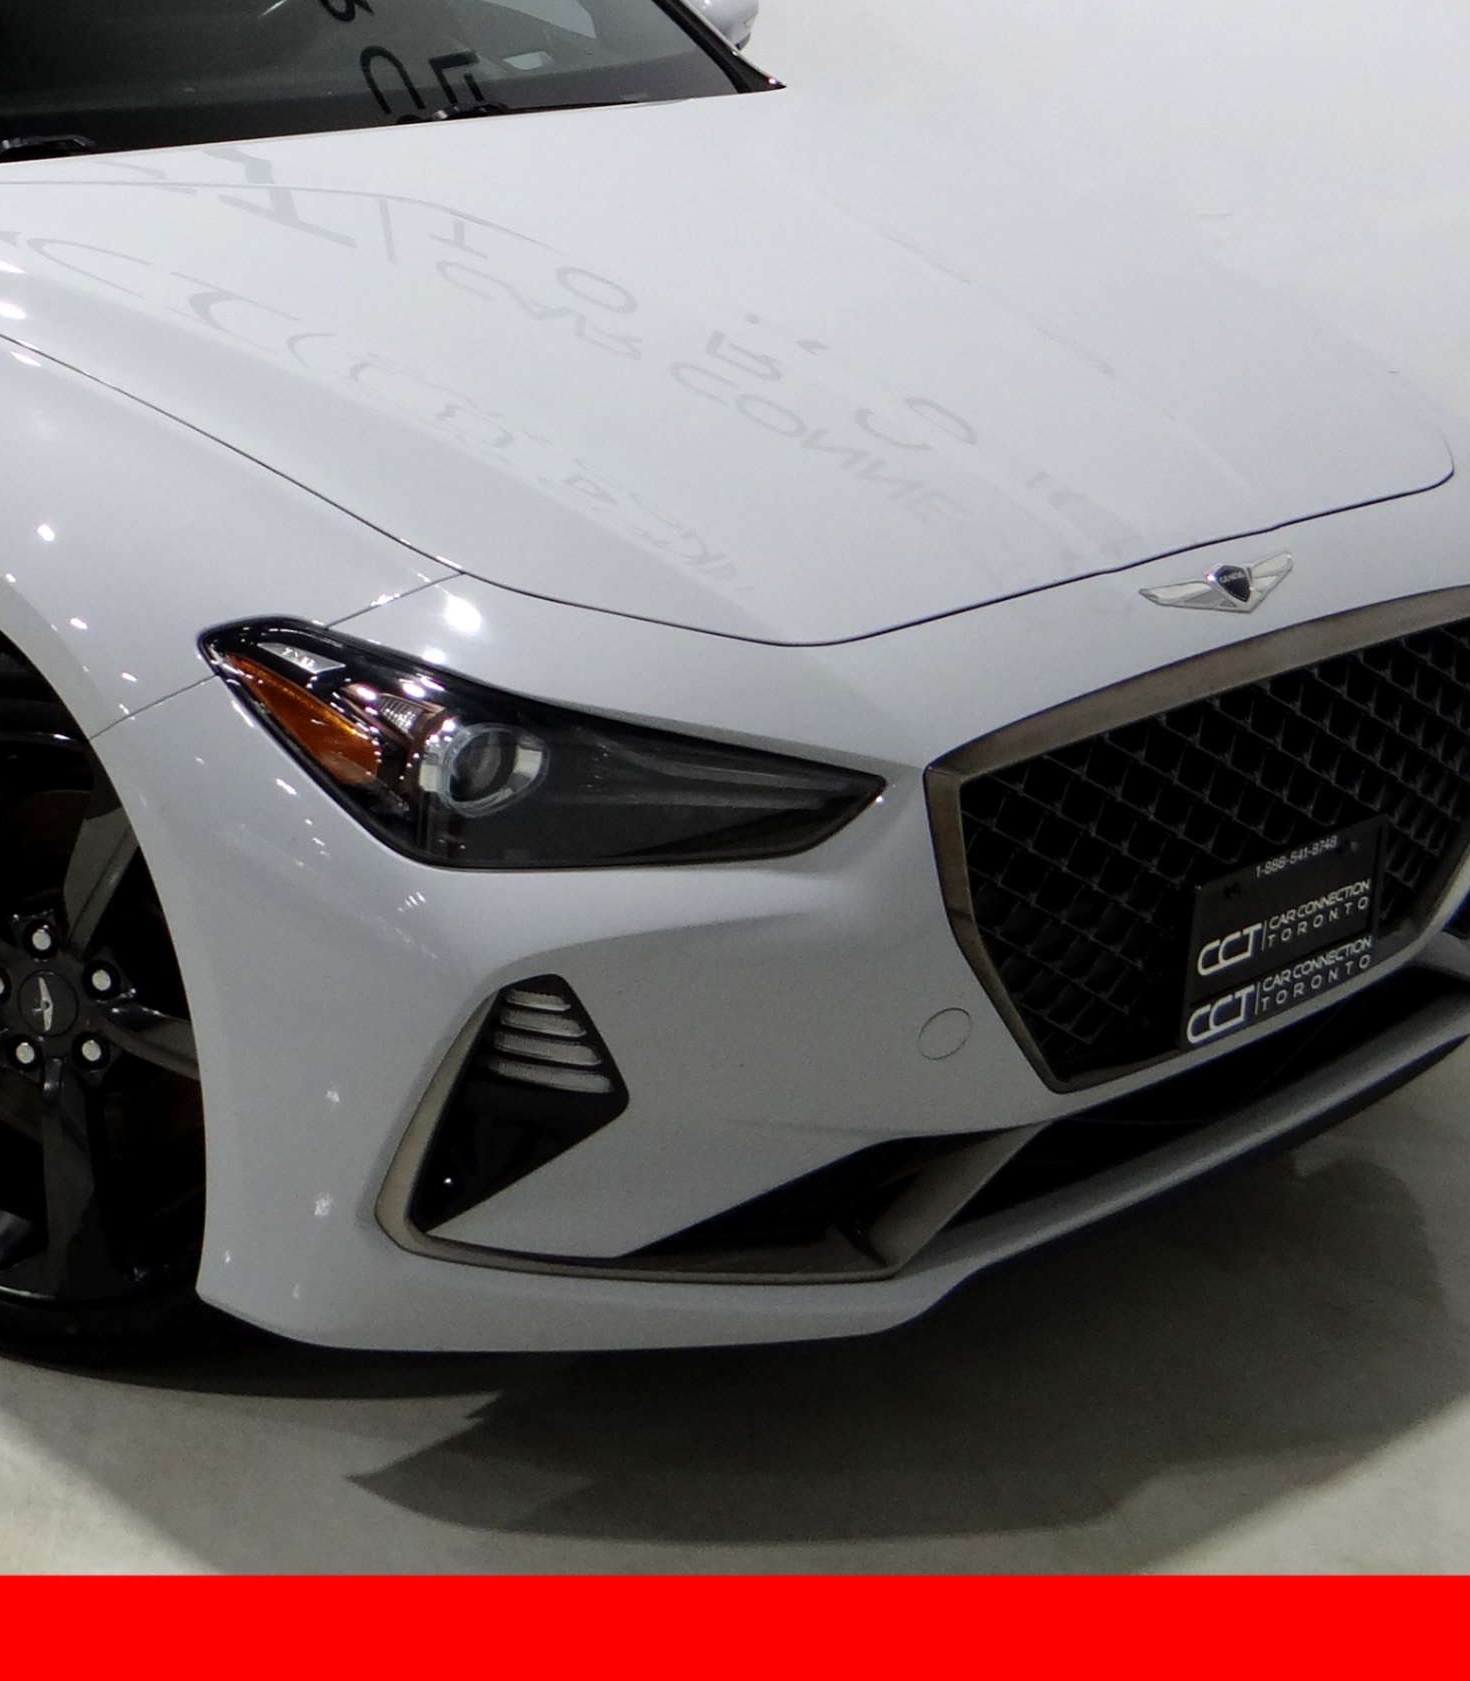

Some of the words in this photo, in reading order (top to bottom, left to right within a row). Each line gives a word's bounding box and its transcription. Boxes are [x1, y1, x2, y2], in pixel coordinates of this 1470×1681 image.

[1267, 896, 1369, 947] TORONTO
[1269, 909, 1297, 930] CAR
[1297, 879, 1371, 918] CONNECTION
[1197, 922, 1262, 976] CCT
[1262, 969, 1291, 992] CAR
[1293, 935, 1372, 979] CONNECTION
[1262, 954, 1371, 1011] TORONTO
[1186, 984, 1255, 1044] CCT
